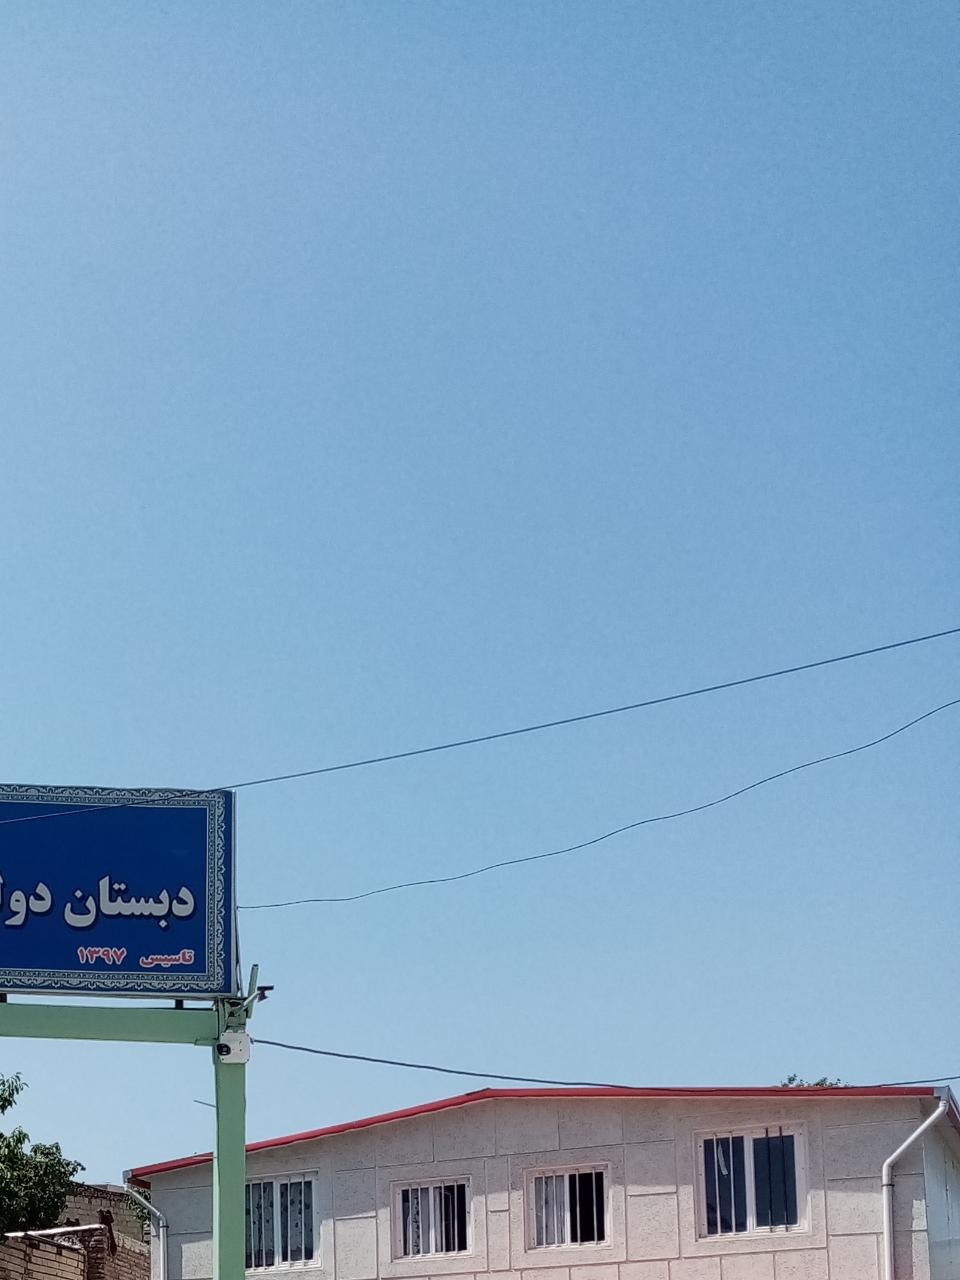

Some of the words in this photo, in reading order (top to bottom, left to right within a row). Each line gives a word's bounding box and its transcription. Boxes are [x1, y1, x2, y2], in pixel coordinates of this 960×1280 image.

[64, 875, 195, 928] دبستان
[77, 946, 127, 966] ۱۳۹۷
[139, 949, 195, 967] تاسیس
